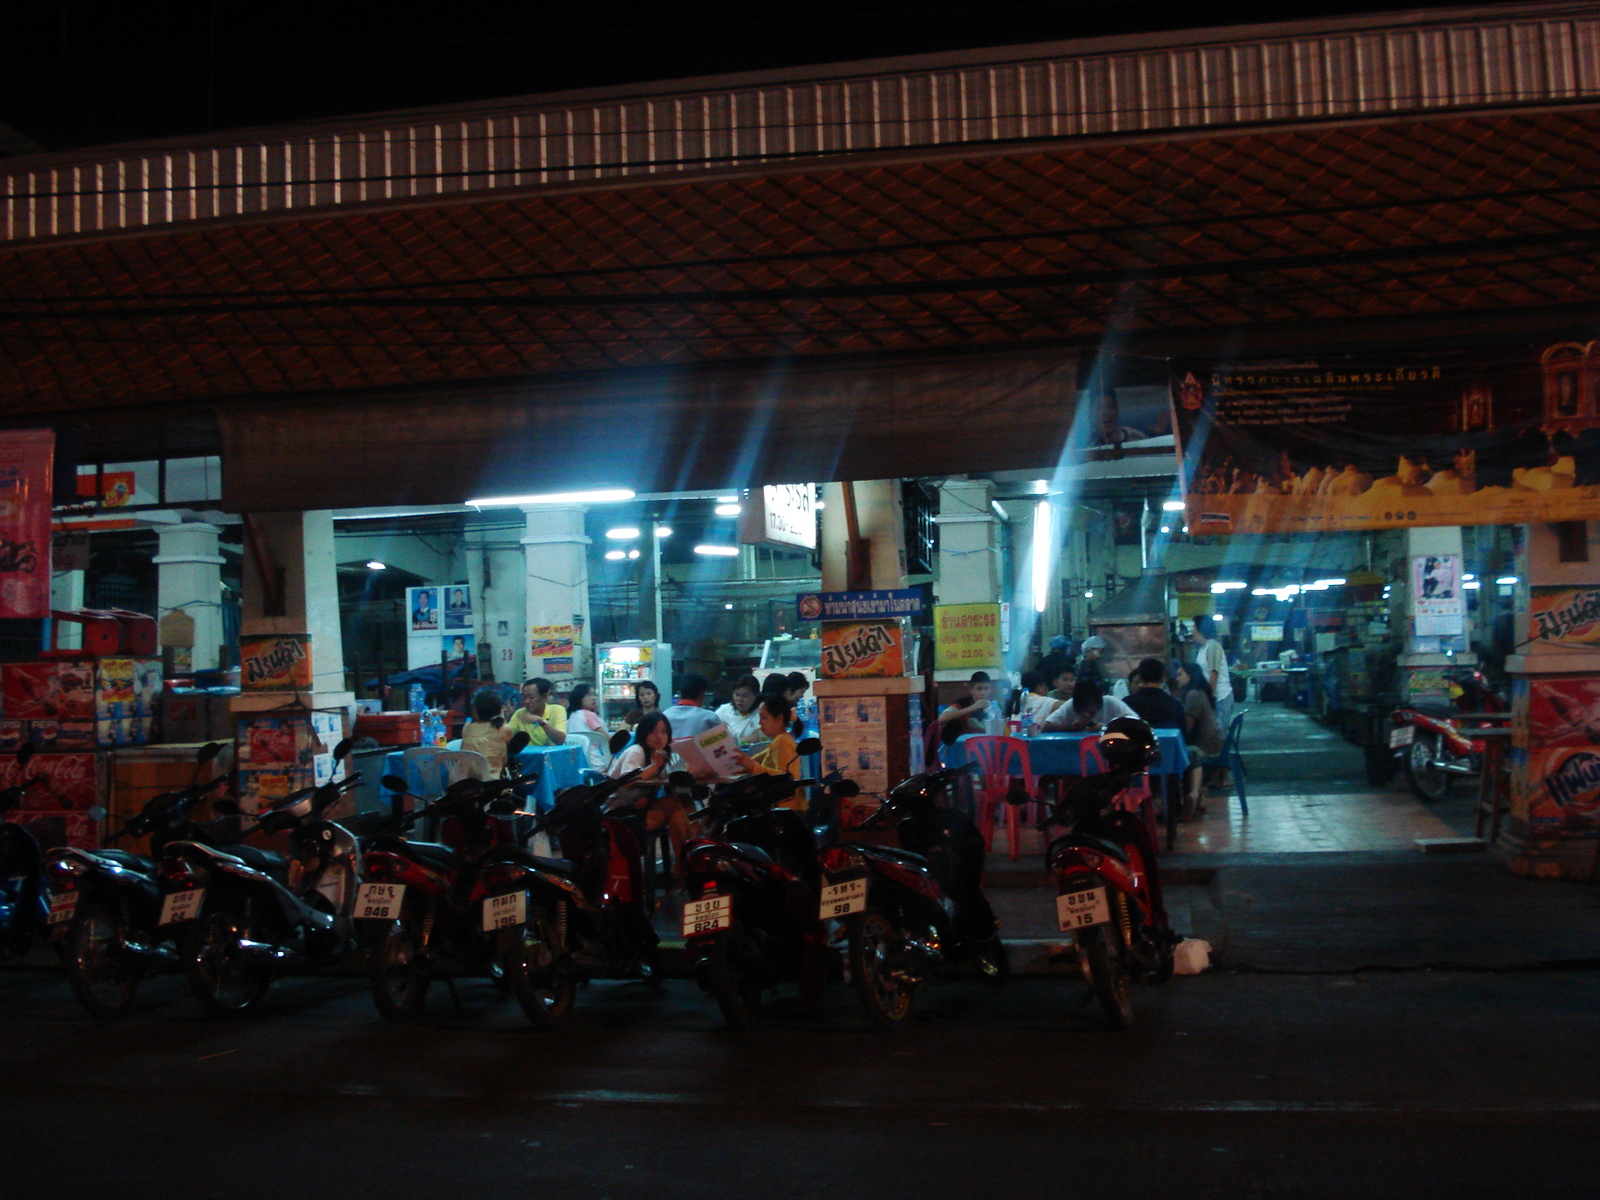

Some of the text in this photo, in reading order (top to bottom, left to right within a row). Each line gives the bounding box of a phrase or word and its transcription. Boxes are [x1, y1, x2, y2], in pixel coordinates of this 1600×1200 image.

[961, 649, 984, 659] 22.00
[364, 906, 389, 916] 946
[834, 903, 850, 914] 98
[1077, 913, 1093, 925] 15
[694, 919, 719, 932] 824
